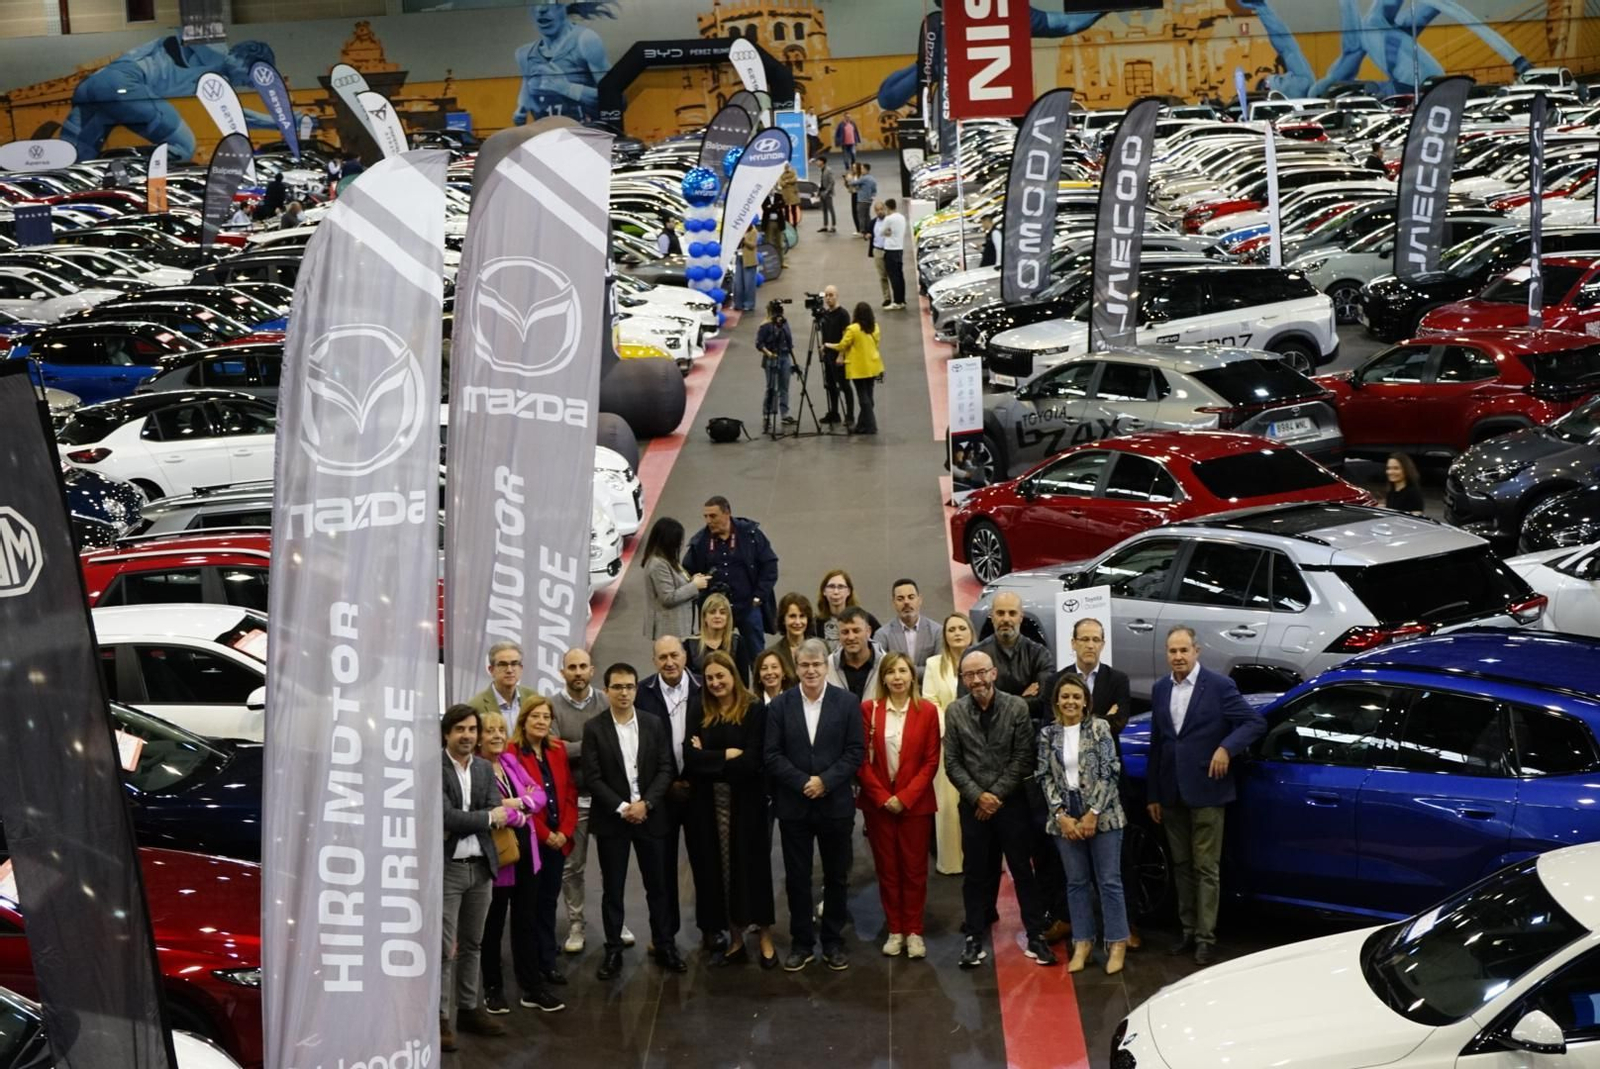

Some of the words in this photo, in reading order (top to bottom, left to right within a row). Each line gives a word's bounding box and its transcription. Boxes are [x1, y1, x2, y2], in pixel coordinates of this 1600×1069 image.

[644, 49, 683, 59] BYD
[731, 182, 764, 231] Hyupersa
[749, 152, 785, 162] HYUNDAI
[1017, 116, 1056, 289] OMODA
[1106, 135, 1143, 334] JAECOO
[1408, 105, 1452, 273] JAECOO
[1022, 406, 1067, 427] TOYOTA
[486, 465, 526, 644] MOTOR
[538, 545, 579, 698] RENSE
[322, 601, 365, 825] MOTOR
[380, 686, 427, 978] OURENSE
[317, 845, 366, 993] HIRO
